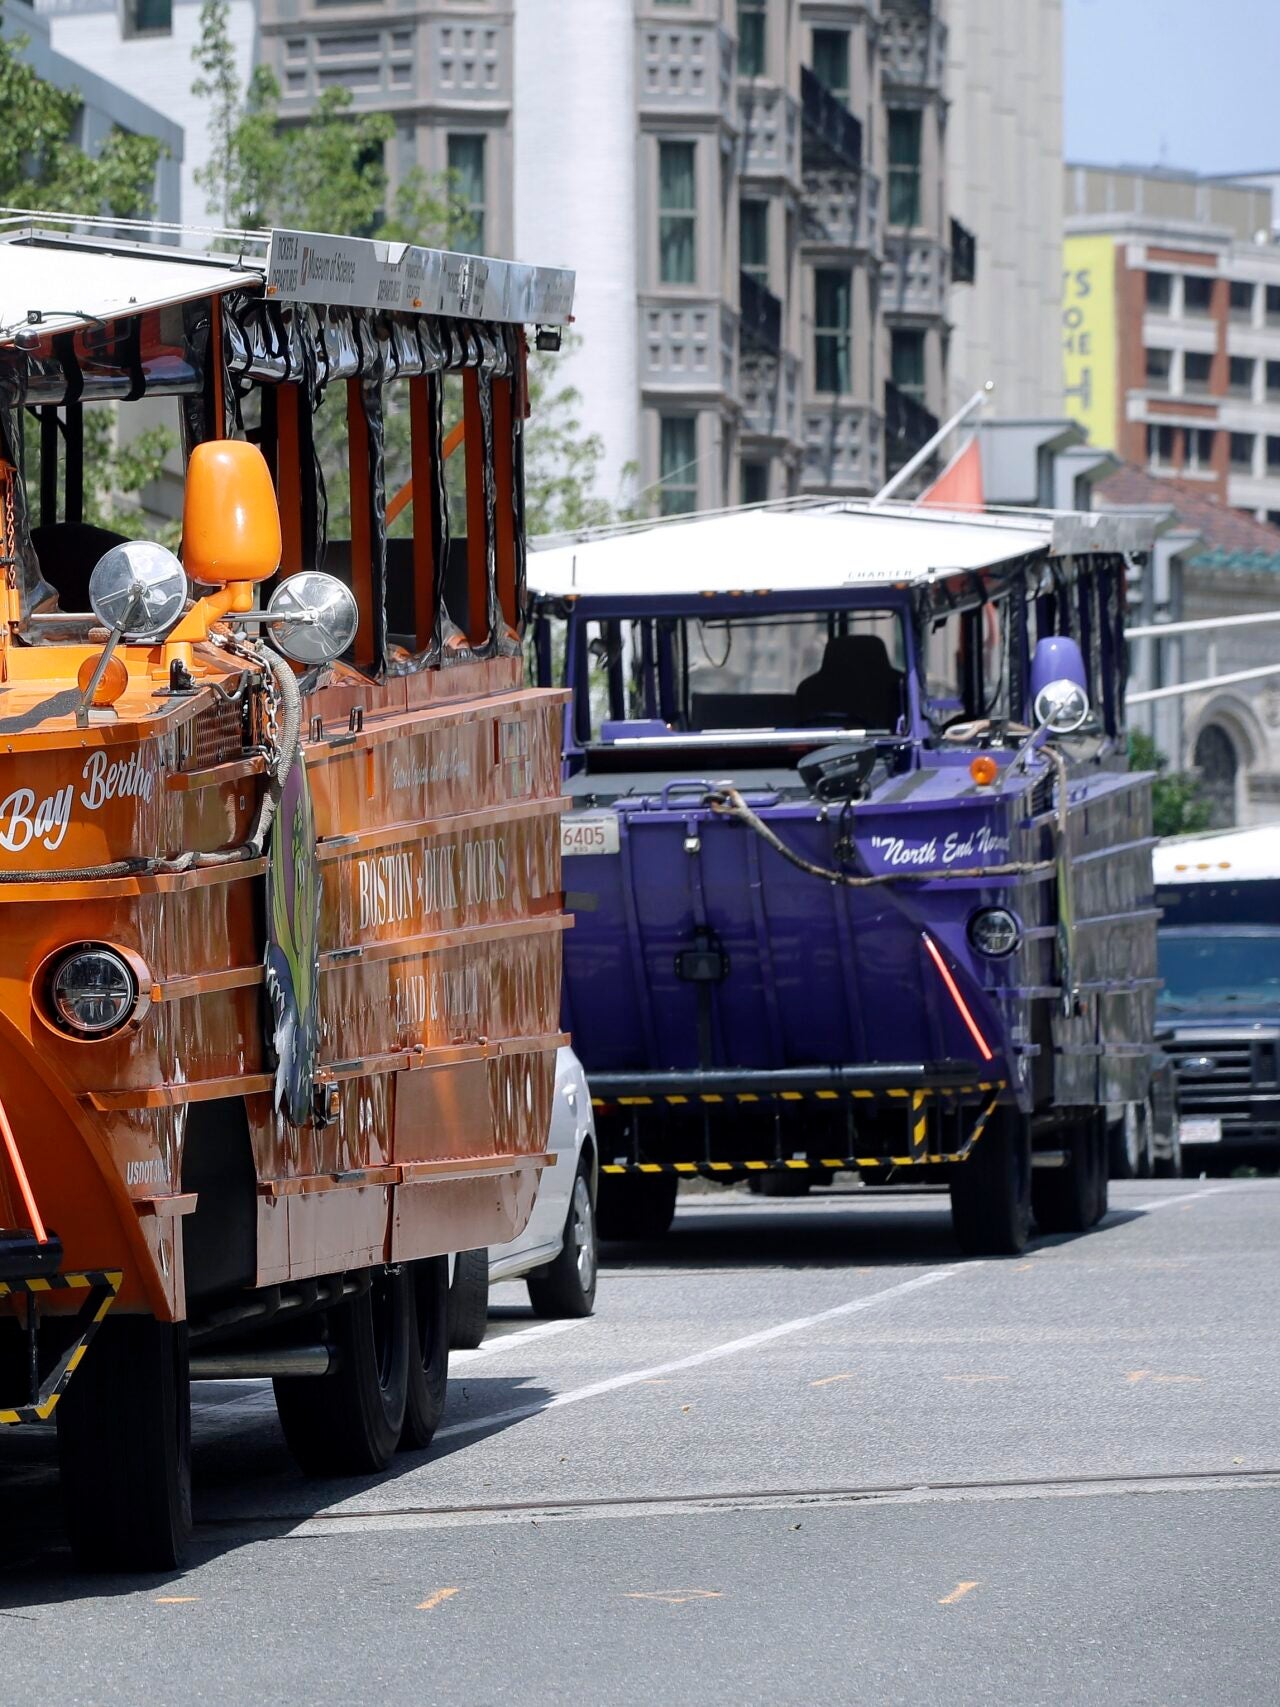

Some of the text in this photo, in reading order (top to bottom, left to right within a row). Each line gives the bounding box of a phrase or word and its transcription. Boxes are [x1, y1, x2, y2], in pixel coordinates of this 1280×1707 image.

[307, 248, 331, 280] Museum
[563, 826, 605, 847] 6405
[942, 832, 975, 863] End
[358, 837, 506, 930] BOSTON DUCK TOURS
